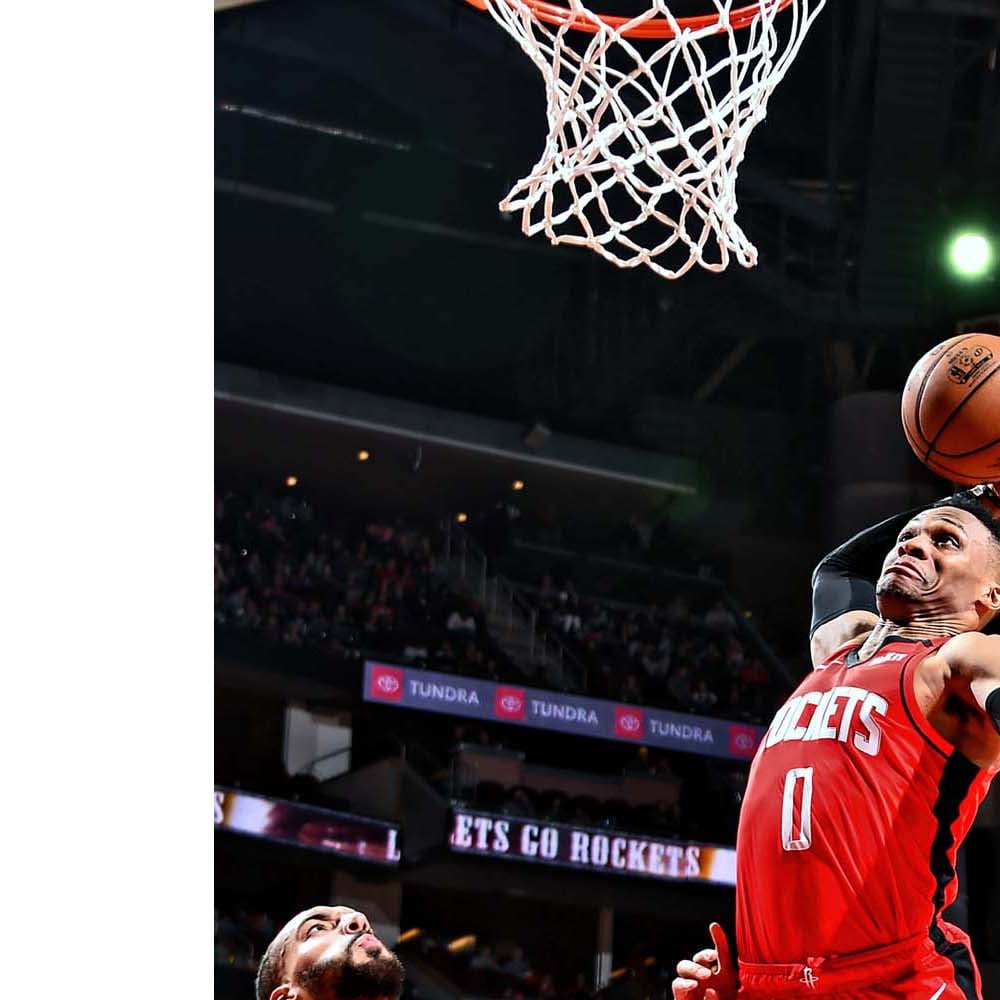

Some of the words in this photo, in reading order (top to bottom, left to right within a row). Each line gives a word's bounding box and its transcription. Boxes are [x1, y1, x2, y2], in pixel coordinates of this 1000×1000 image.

[408, 679, 480, 706] TUNDRA
[531, 700, 599, 725] TUNDRA
[649, 719, 714, 744] TUNDRA
[781, 767, 814, 851] 0
[521, 824, 558, 859] GO
[570, 831, 701, 877] ROCKETS
